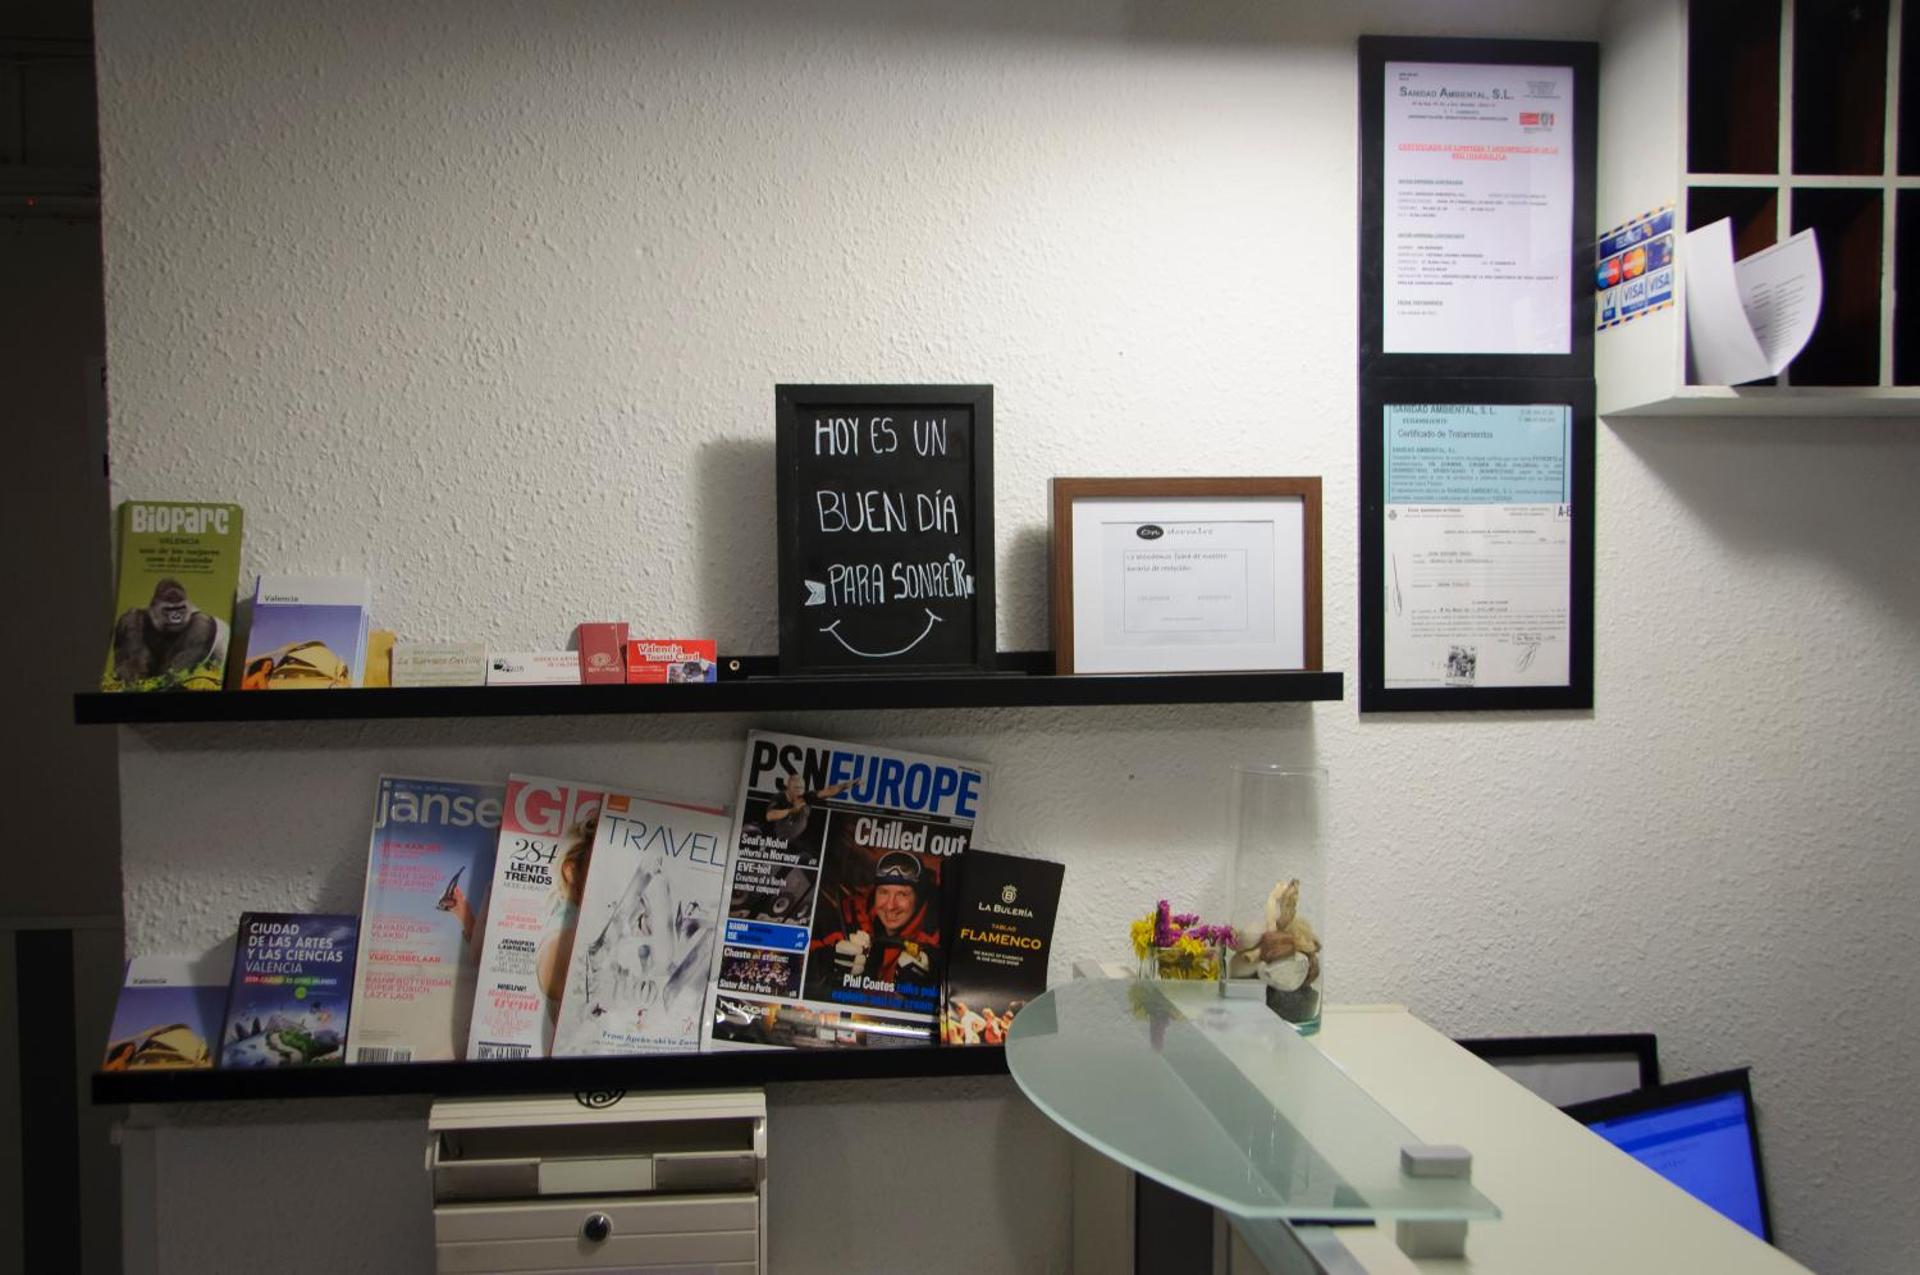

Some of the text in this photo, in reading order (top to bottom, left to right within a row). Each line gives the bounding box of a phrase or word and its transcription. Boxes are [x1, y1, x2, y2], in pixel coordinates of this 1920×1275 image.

[814, 417, 946, 456] HOY ES UN
[816, 488, 959, 534] BUEN DÍA
[827, 563, 886, 607] PARA
[264, 594, 300, 602] Valencia
[638, 644, 682, 654] Valencia
[676, 652, 700, 662] Card
[606, 814, 726, 868] TRAVEL
[854, 816, 968, 856] Chilled out
[510, 838, 559, 864] 284
[770, 850, 800, 864] Norway
[511, 862, 549, 875] LENTE
[504, 871, 553, 886] TRENDS
[250, 922, 300, 935] CIUDAD
[248, 936, 334, 950] DE LAS ARTES
[502, 938, 535, 946] JENNIFER
[960, 928, 1042, 951] FLAMENCO
[248, 948, 344, 962] Y LAS CIENCIAS
[246, 962, 304, 974] VALENCIA
[498, 983, 527, 992] NIEUW!
[719, 978, 738, 989] Sister
[738, 980, 749, 990] Act
[755, 984, 772, 993] Paris
[842, 973, 862, 988] Phil
[494, 998, 540, 1010] trend
